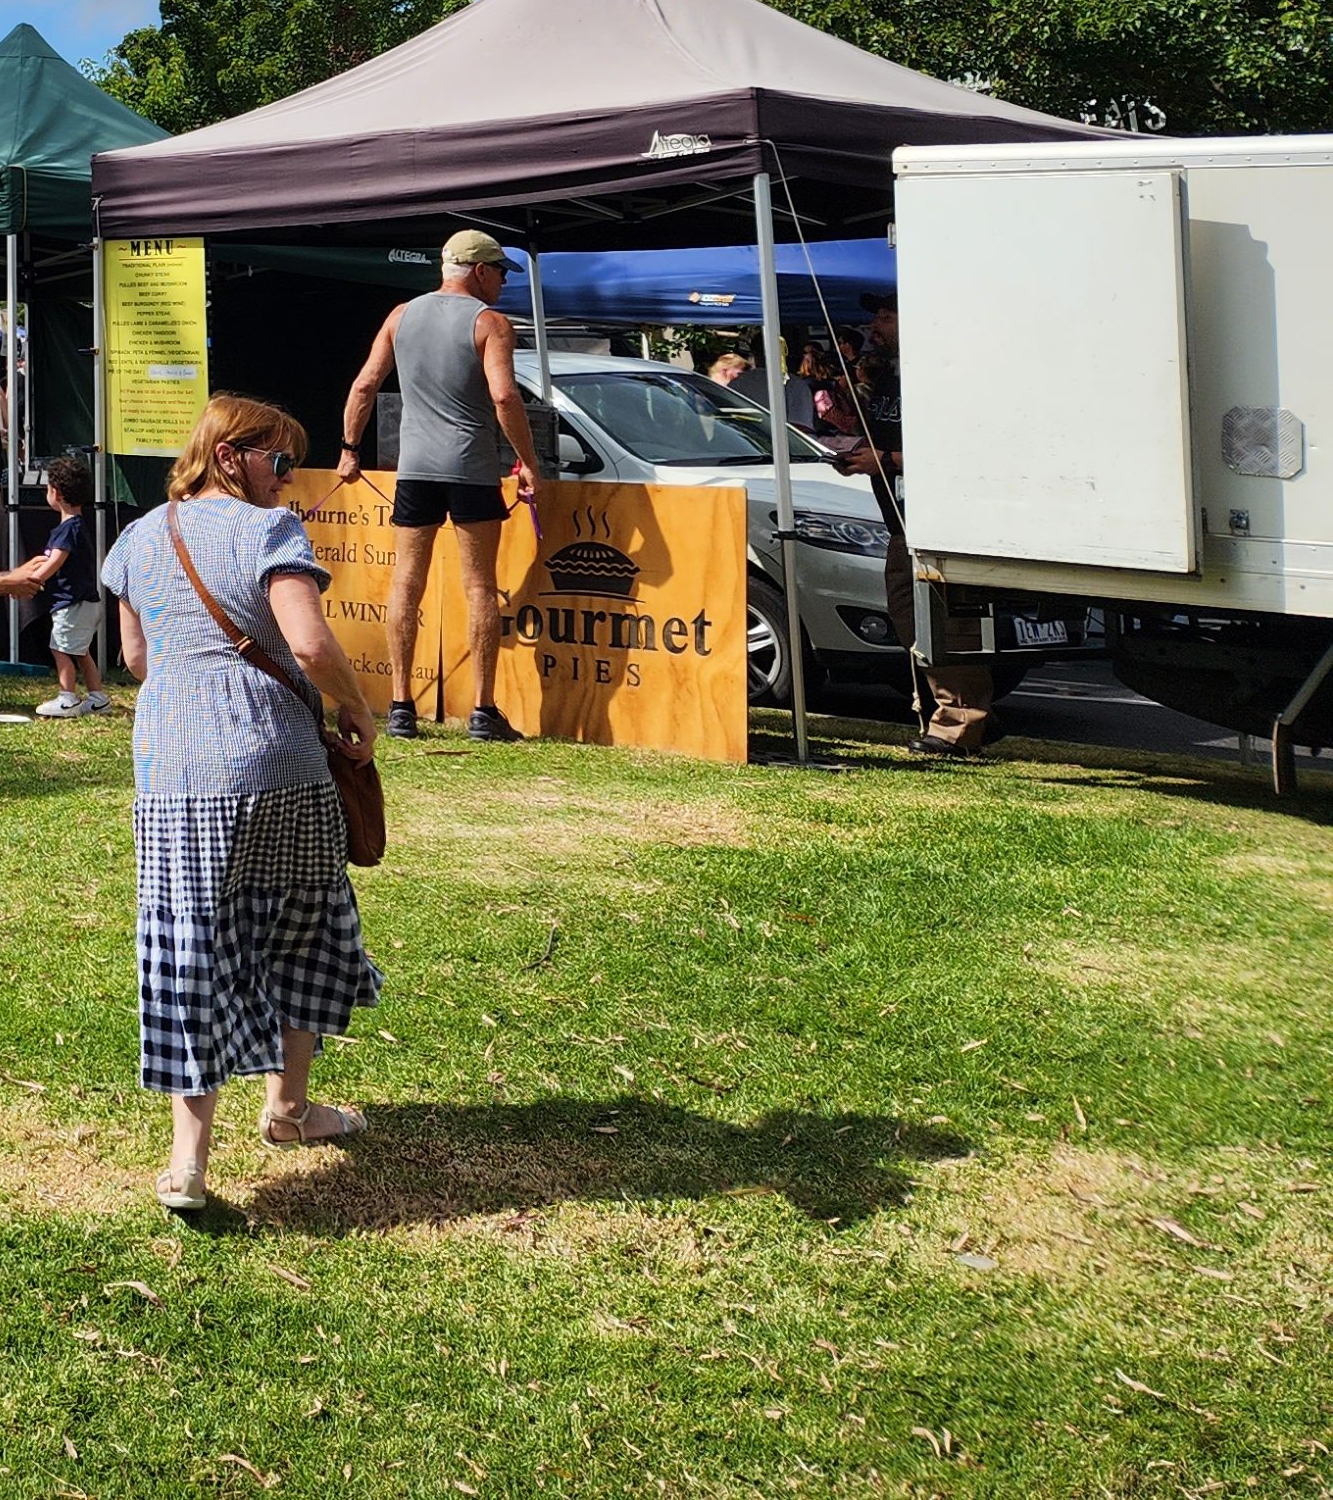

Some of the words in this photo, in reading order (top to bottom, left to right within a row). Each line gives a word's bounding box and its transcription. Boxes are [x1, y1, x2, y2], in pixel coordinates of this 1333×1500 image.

[130, 239, 174, 257] MENU
[310, 540, 358, 565] erald
[542, 653, 642, 687] PIES
